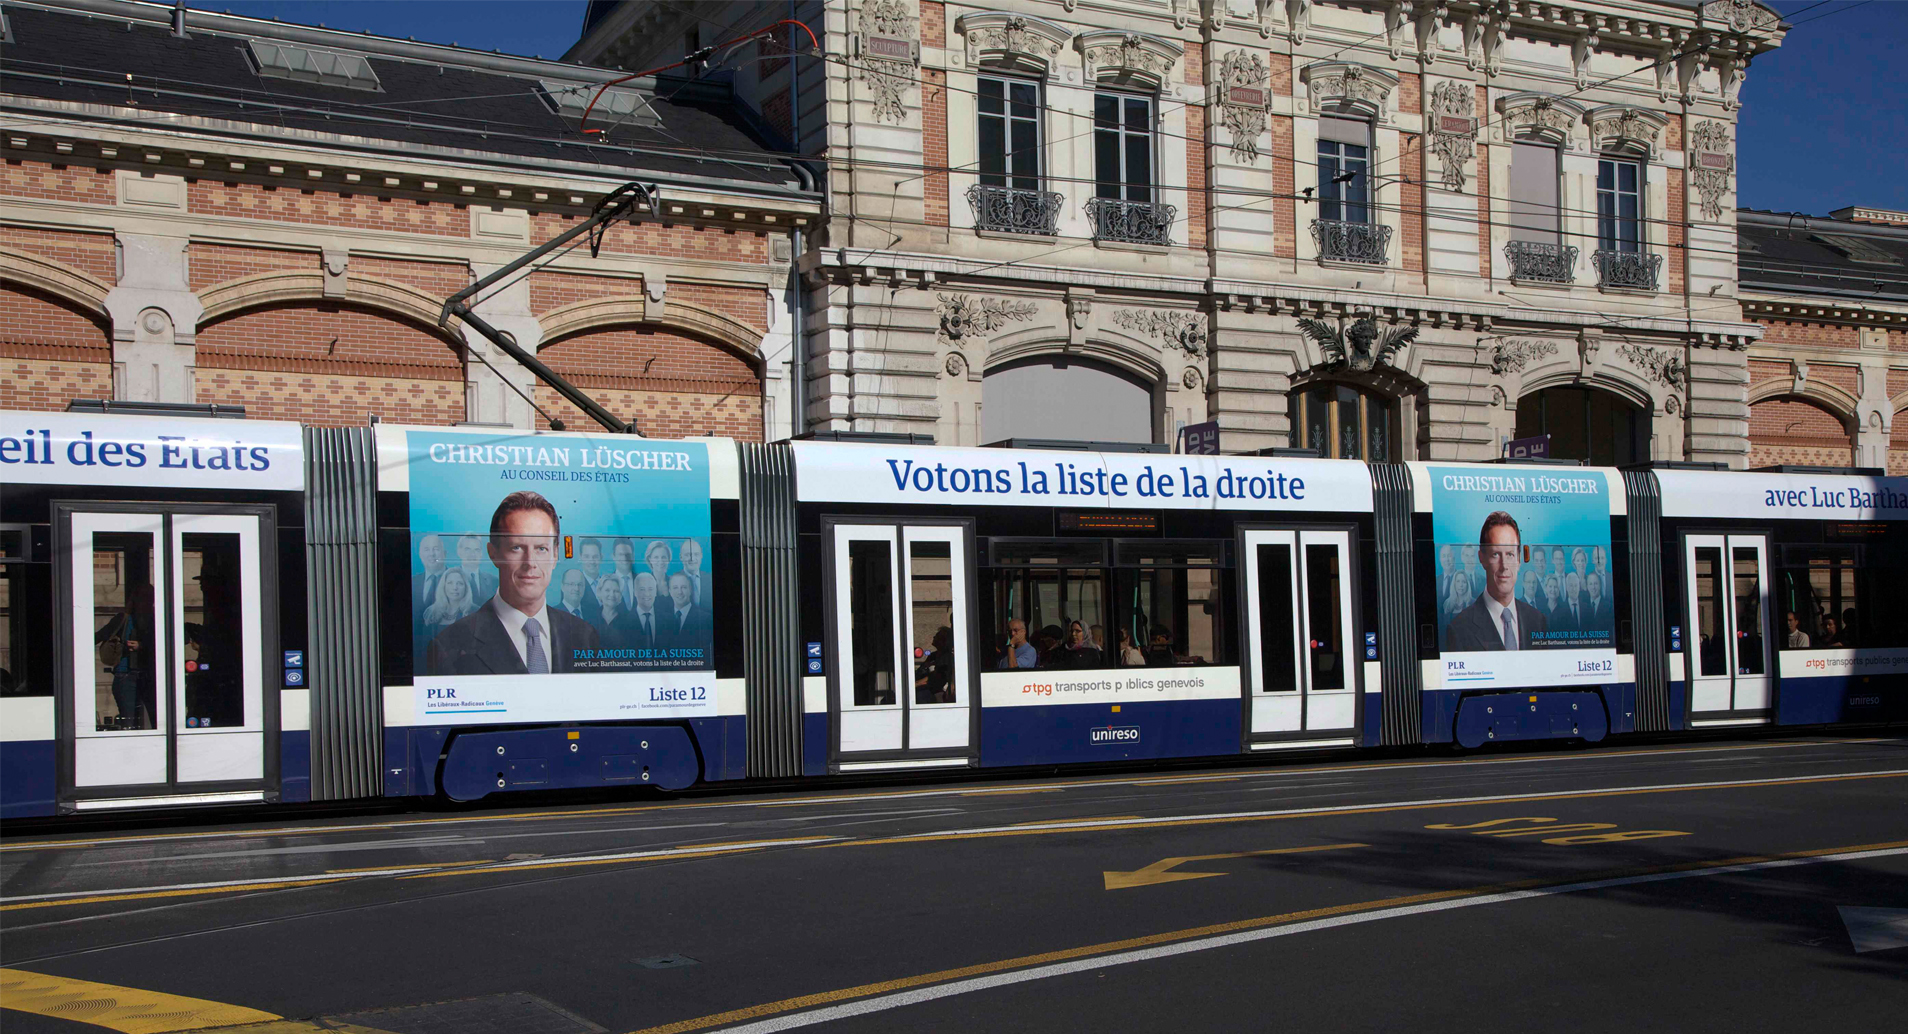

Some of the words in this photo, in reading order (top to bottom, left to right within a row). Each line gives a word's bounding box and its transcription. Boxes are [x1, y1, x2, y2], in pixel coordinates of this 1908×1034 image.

[870, 40, 908, 55] SCULPTURE
[1702, 155, 1725, 166] BRONZE
[0, 429, 54, 465] eil
[67, 431, 147, 468] des
[158, 435, 270, 471] Etats
[429, 443, 570, 467] CHRISTIAN
[580, 445, 692, 472] LÜSCHER
[500, 469, 518, 480] AU
[519, 470, 569, 482] CONSEIL
[570, 471, 592, 483] DES
[594, 470, 630, 483] ÉTATS
[886, 459, 1012, 494] Votons
[1018, 462, 1050, 495] la
[1057, 463, 1128, 497] liste
[1136, 465, 1174, 498] de
[1180, 466, 1210, 499] la
[1216, 468, 1306, 500] droite
[1443, 475, 1526, 493] CHRISTIAN
[1531, 475, 1599, 494] LÜSCHER
[1484, 494, 1495, 503] AU
[1495, 495, 1525, 504] CONSEIL
[1526, 495, 1540, 504] DES
[1540, 495, 1562, 504] ÉTATS
[1765, 489, 1808, 508] avec
[1809, 486, 1846, 508] Luc
[1847, 487, 1908, 509] Bartha
[1531, 631, 1545, 639] PAR
[1545, 631, 1569, 639] AMOUR
[1579, 630, 1588, 638] LA
[1588, 630, 1610, 638] SUISSE
[573, 649, 595, 659] PAR
[596, 649, 636, 659] AMOUR
[638, 649, 653, 658] DE
[654, 648, 668, 658] LA
[669, 648, 704, 658] SUISSE
[600, 660, 633, 668] Barthassat,
[1447, 661, 1465, 669] PLR
[1577, 660, 1601, 672] Liste
[1602, 659, 1612, 671] 12
[1812, 659, 1826, 670] tpg
[1826, 658, 1863, 668] transports
[1864, 656, 1891, 667] publics
[426, 688, 457, 699] PLR
[1033, 683, 1053, 696] tpg
[1055, 680, 1112, 694] transports
[1157, 677, 1205, 692] genevois
[649, 687, 687, 702] Liste
[690, 686, 706, 701] 12
[1849, 695, 1880, 706] unireso
[1092, 725, 1138, 741] unireso
[1423, 816, 1695, 847] BUS
